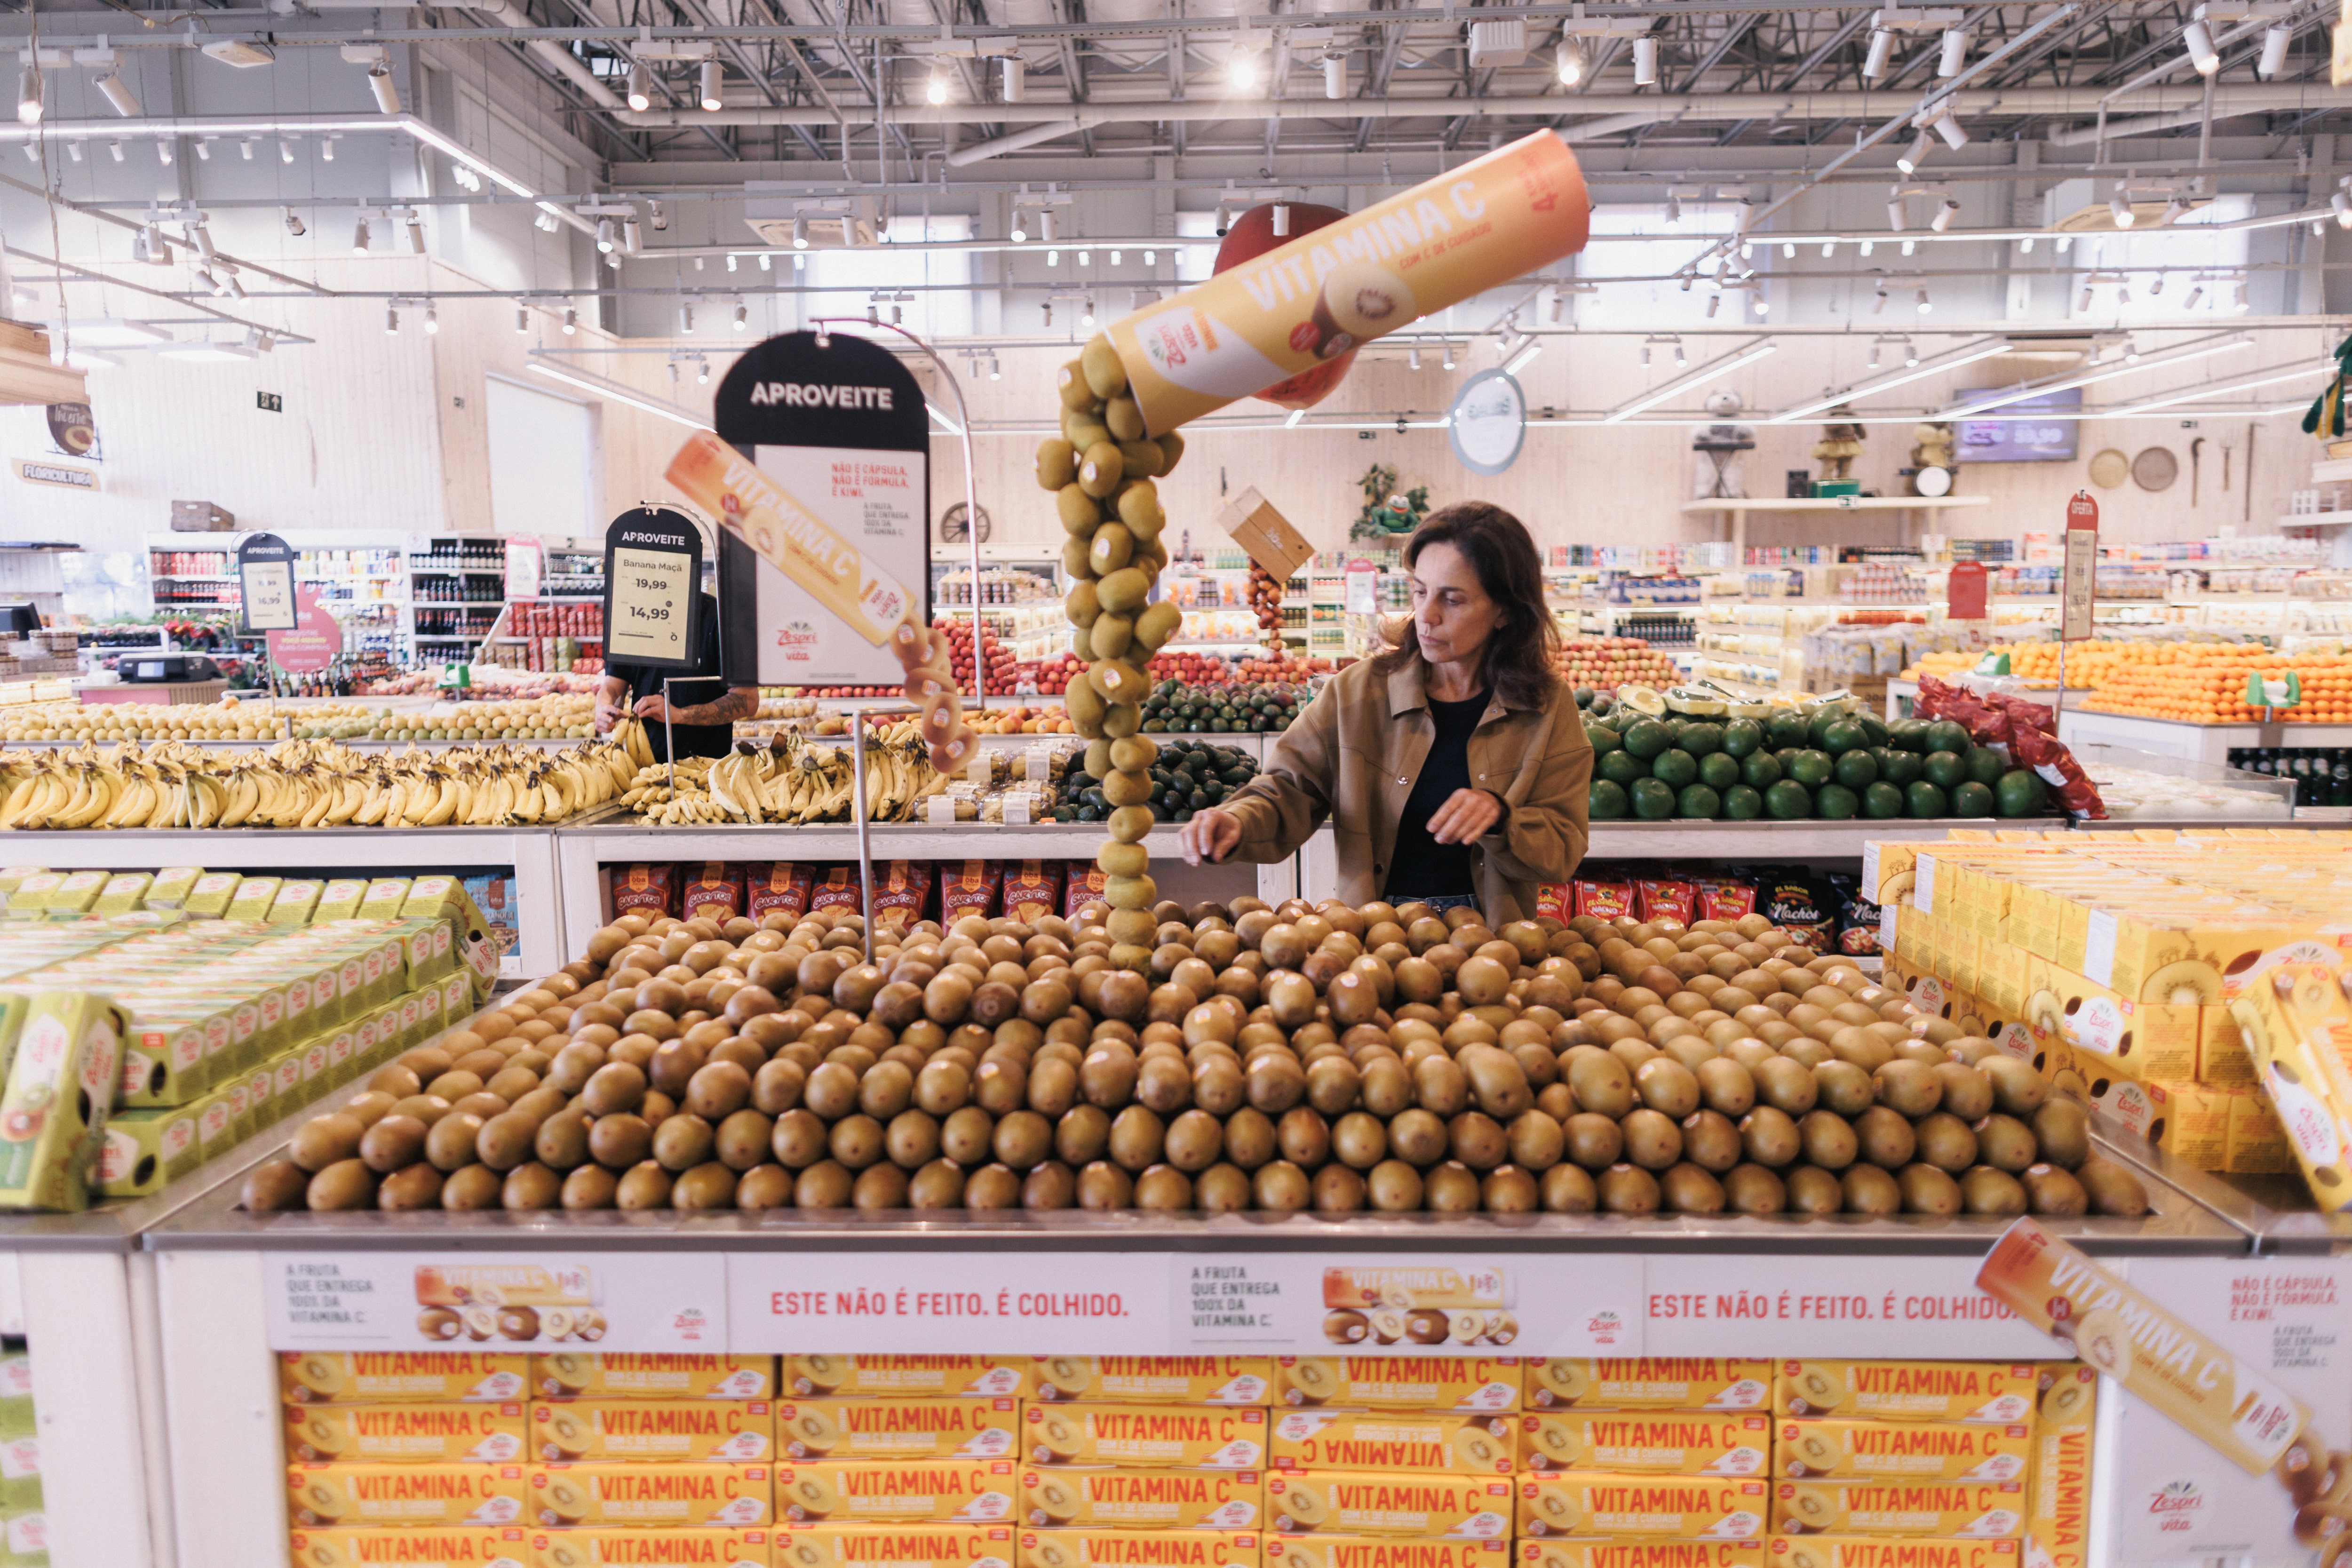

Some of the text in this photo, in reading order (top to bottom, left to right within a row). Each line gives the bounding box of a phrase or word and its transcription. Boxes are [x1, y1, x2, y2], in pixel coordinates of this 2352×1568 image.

[1242, 181, 1486, 312] VITAMINA C
[750, 382, 893, 410] APROVEITE
[24, 464, 92, 487] FLORICULTURA
[832, 462, 850, 472] NÃO
[832, 473, 851, 485] NÃO
[841, 487, 864, 497] KIWI.
[2072, 502, 2092, 515] OFERTA
[722, 462, 856, 575] VITAMINA C
[622, 531, 685, 545] APROVEITE
[623, 559, 682, 572] Banana Maçã
[636, 578, 667, 589] 19,99
[630, 606, 669, 620] 14,99
[778, 630, 817, 645] Zespri
[786, 651, 809, 660] vita
[1784, 884, 1809, 895] SABOR
[1592, 906, 1618, 915] NACHO
[1774, 903, 1819, 920] Nachos
[1923, 985, 1939, 1003] Zespri
[2009, 1031, 2029, 1055] Zespri
[287, 1264, 340, 1276] A FRUTA
[1192, 1266, 1246, 1279] A FRUTA
[287, 1279, 373, 1293] QUE ENTREGA
[1192, 1282, 1279, 1295] QUE ENTREGA
[1351, 1271, 1456, 1289] VITAMINA C
[2232, 1276, 2259, 1290] NÃO
[290, 1295, 340, 1308] 100% DA
[771, 1287, 1129, 1317] ESTE NÃO É FEITO. É COLHIDO.
[1193, 1298, 1245, 1310] 100% DA
[1649, 1294, 1707, 1318] ESTE
[1716, 1290, 1767, 1318] NÃO
[1778, 1290, 1790, 1318] É
[1800, 1296, 1873, 1319] FEITO.
[1884, 1290, 1897, 1319] É
[2231, 1291, 2259, 1305] NÃO
[290, 1311, 351, 1323] VITAMINA
[1192, 1314, 1255, 1326] VITAMINA
[1588, 1319, 1622, 1331] Zespri
[2049, 1255, 2227, 1389] VITAMINA C
[1100, 1356, 1240, 1378] VITAMINA C
[1348, 1357, 1491, 1385] VITAMINA C
[1855, 1367, 2004, 1397] VITAMINA C
[847, 1406, 987, 1432] VITAMINA C
[1094, 1414, 1235, 1443] VITAMINA C
[1592, 1422, 1714, 1449] VITAMINA
[1722, 1424, 1737, 1449] C
[1852, 1430, 1998, 1457] VITAMINA C
[1302, 1439, 1444, 1467] VITAMINA C
[599, 1475, 739, 1500] VITAMINA C
[1090, 1477, 1230, 1504] VITAMINA C
[1337, 1485, 1457, 1513] VITAMINA
[1465, 1489, 1480, 1514] C
[1591, 1488, 1735, 1514] VITAMINA C
[2053, 1433, 2085, 1567] VITAMINA C
[2150, 1493, 2202, 1513] Zespri
[2161, 1519, 2192, 1530] vita
[359, 1536, 496, 1561] VITAMINA C
[843, 1535, 983, 1560] VITAMINA C
